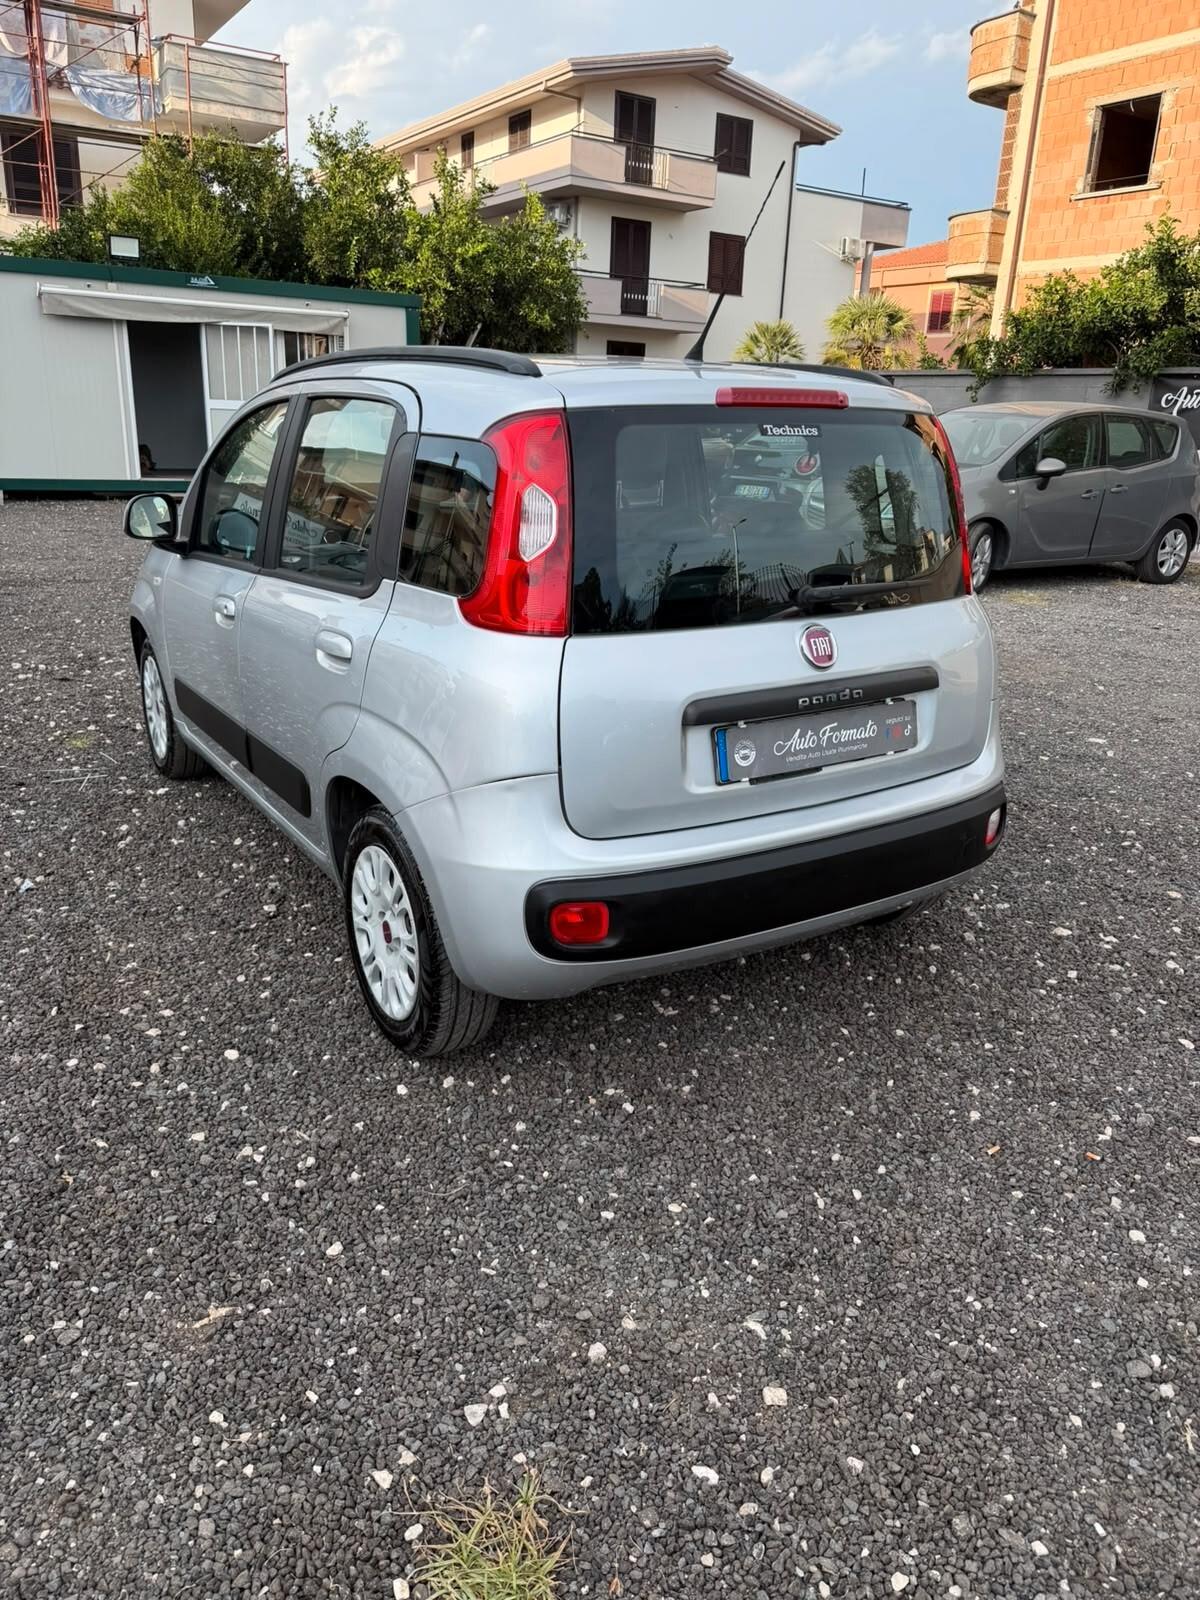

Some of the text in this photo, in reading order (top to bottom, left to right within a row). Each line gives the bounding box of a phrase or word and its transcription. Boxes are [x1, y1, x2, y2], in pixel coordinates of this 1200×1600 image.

[763, 424, 818, 436] Technics
[810, 636, 832, 657] FIAT
[798, 688, 863, 709] panda
[773, 728, 818, 756] Auto
[819, 720, 878, 748] Formato
